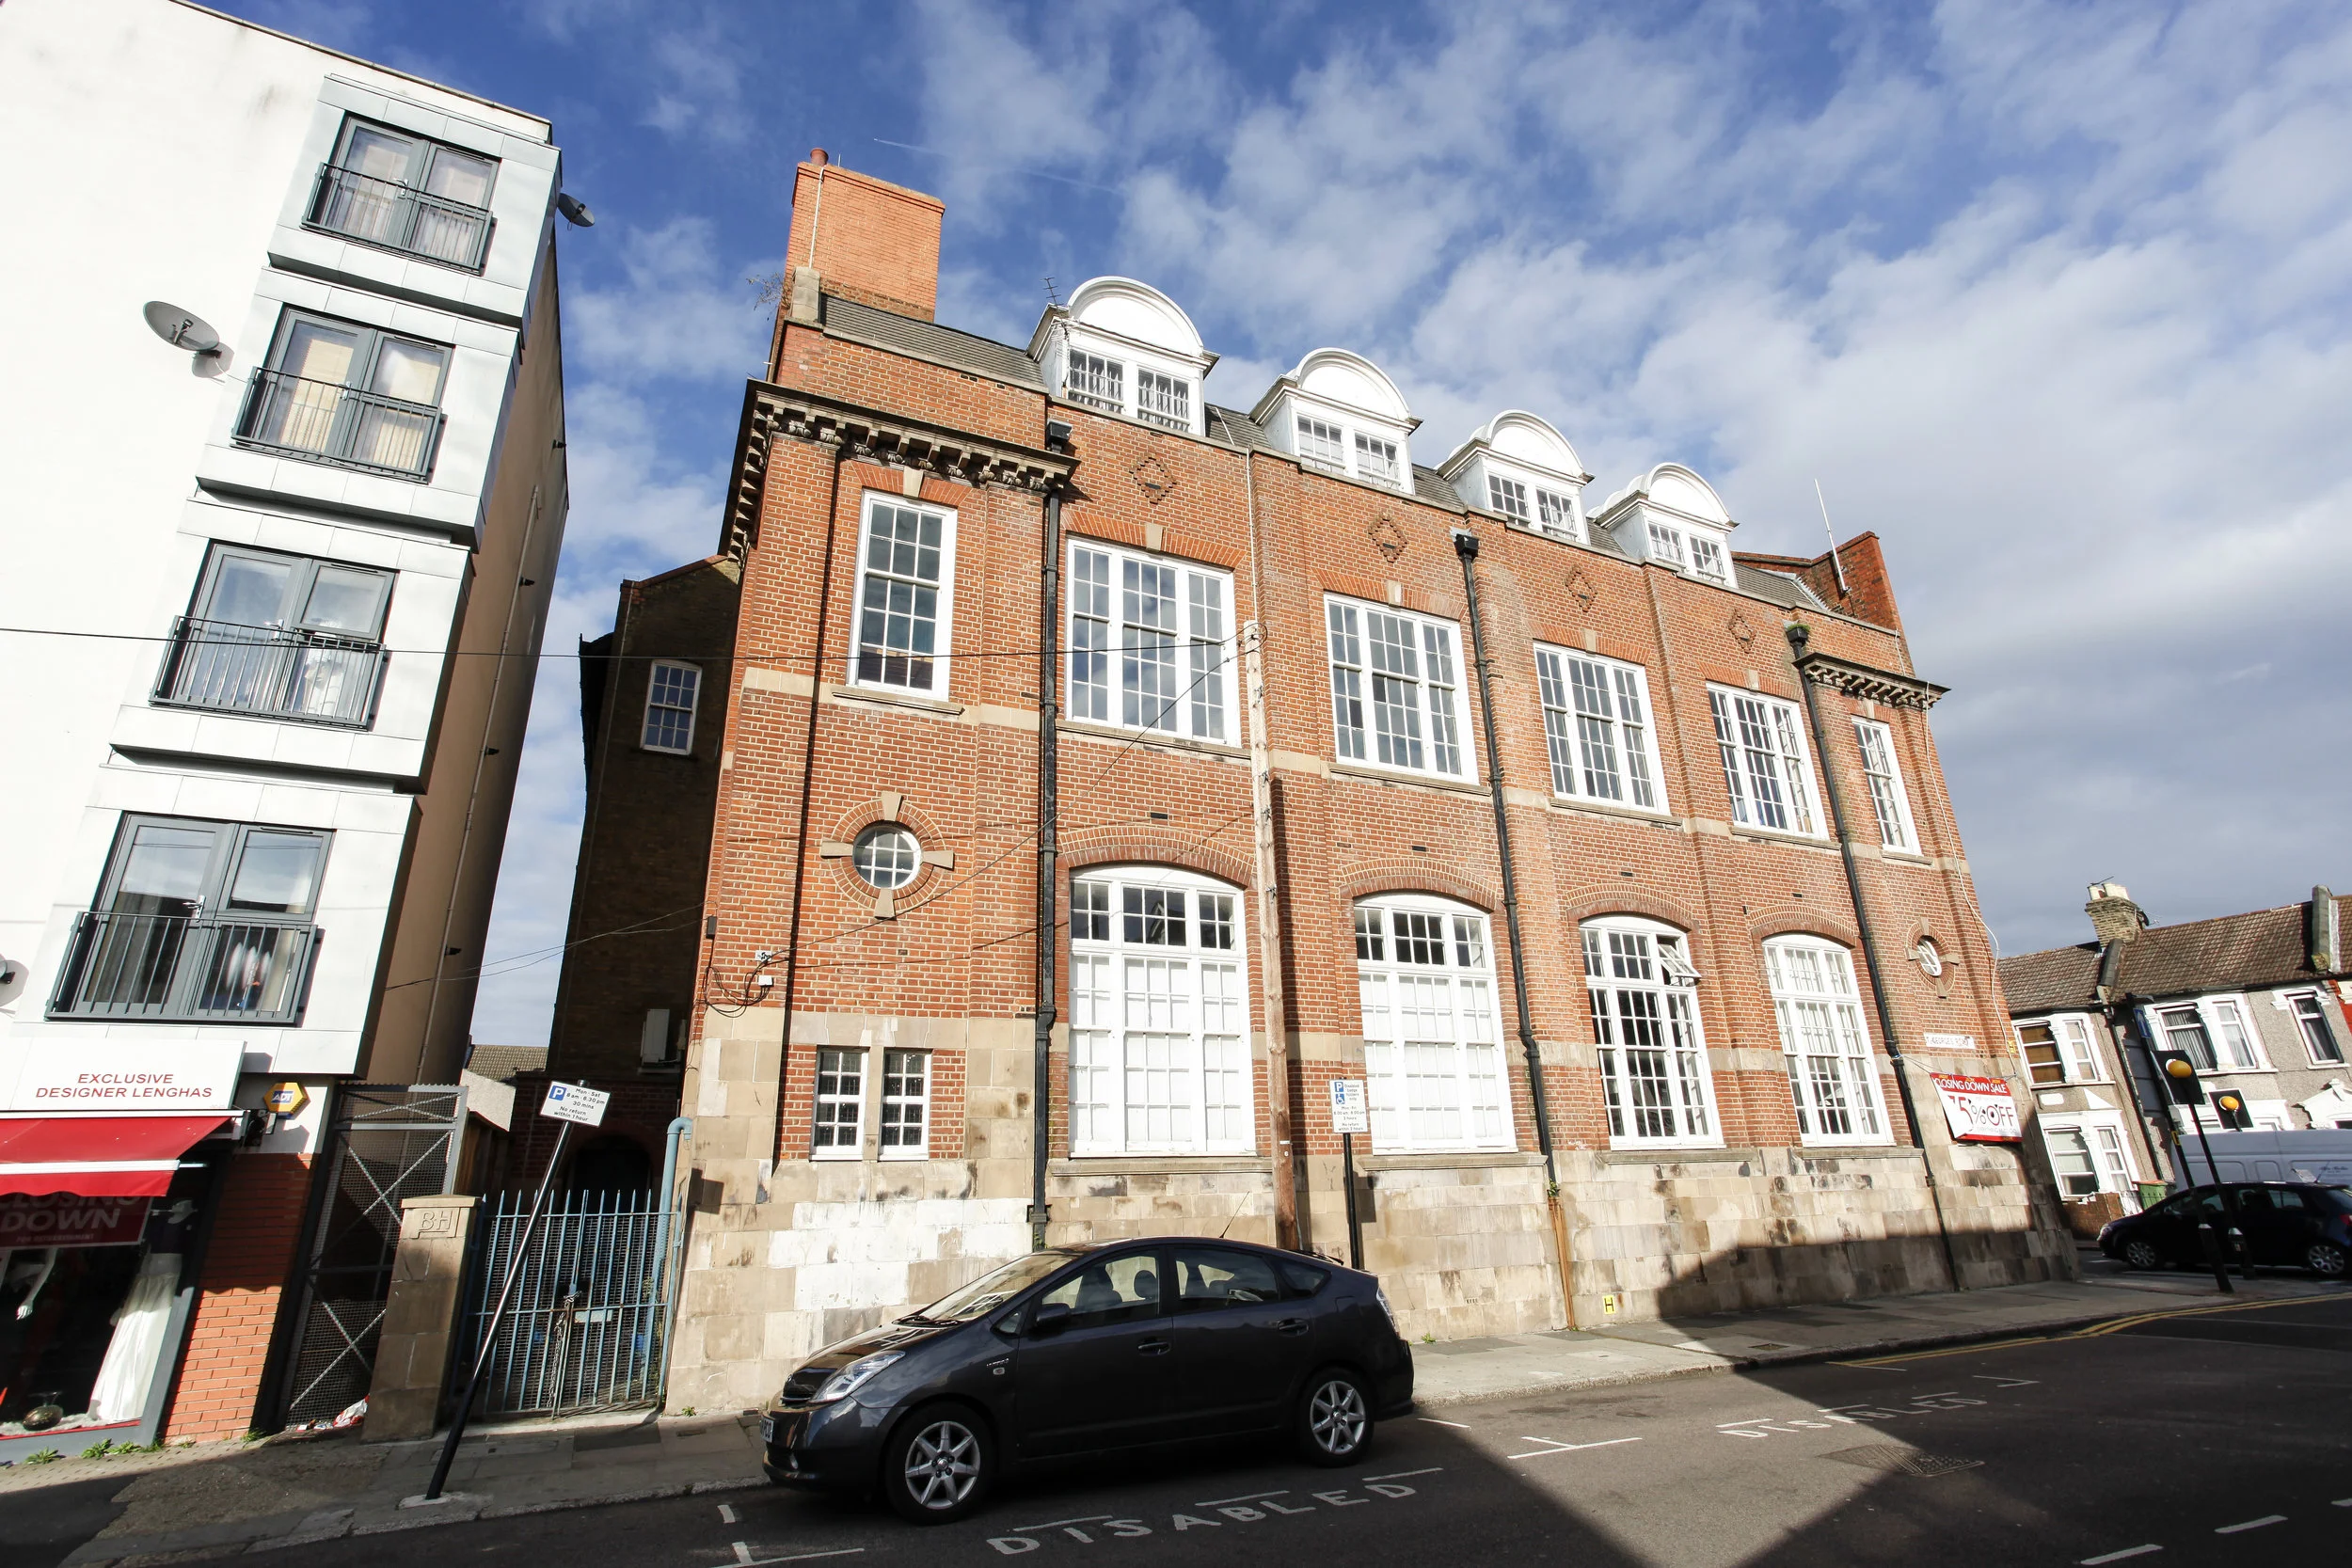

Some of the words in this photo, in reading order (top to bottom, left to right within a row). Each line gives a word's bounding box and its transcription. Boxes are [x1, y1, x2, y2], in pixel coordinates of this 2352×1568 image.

[77, 1073, 174, 1084] EXCLUSIVE
[1933, 1078, 1964, 1090] CLOSING
[1964, 1082, 1990, 1092] DOWN
[1990, 1083, 2008, 1094] SALE
[36, 1087, 128, 1098] DESIGNER
[132, 1087, 213, 1098] LENGHAS
[272, 1092, 292, 1101] ADT
[552, 1087, 564, 1098] P
[1986, 1105, 2013, 1127] OFF
[0, 1208, 120, 1232] DOWN
[1604, 1297, 1614, 1312] H
[1718, 1398, 1987, 1438] DISABLED
[986, 1483, 1416, 1555] DISABLED
